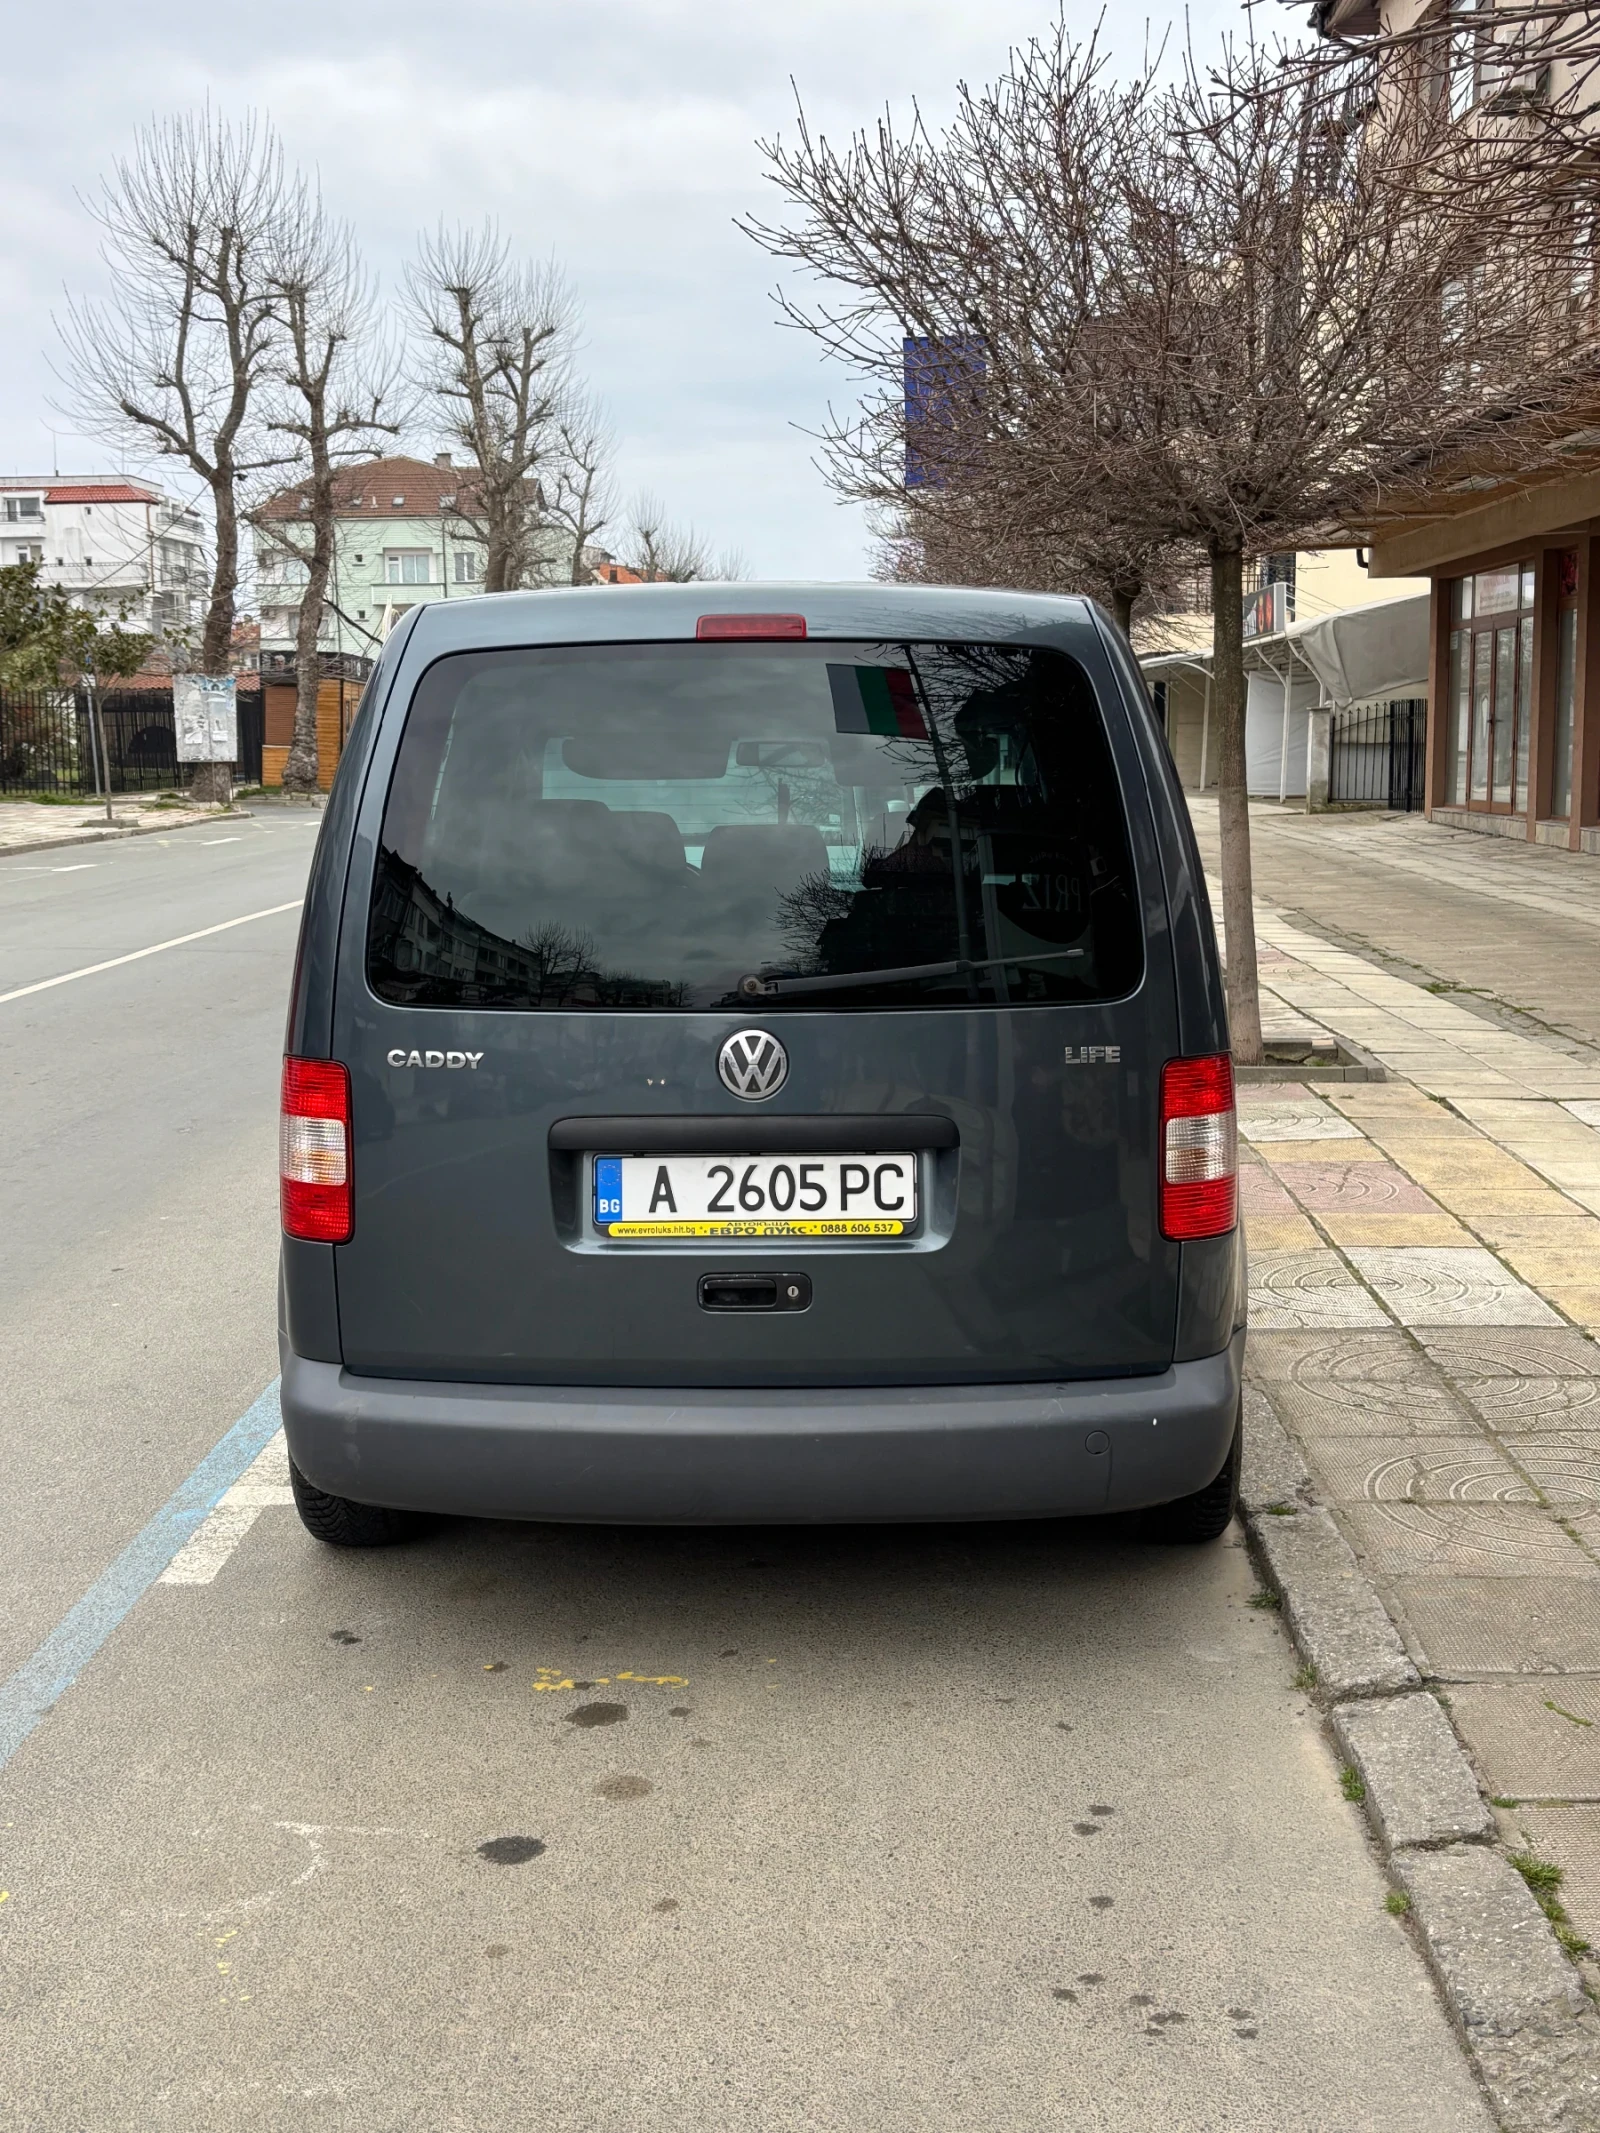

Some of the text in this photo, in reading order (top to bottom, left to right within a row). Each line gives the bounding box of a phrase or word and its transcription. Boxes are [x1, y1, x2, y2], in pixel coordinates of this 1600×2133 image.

[387, 1049, 485, 1070] CADDY
[719, 1029, 787, 1099] VW
[1065, 1045, 1121, 1064] LIFE
[649, 1166, 677, 1213] A
[599, 1199, 620, 1213] BG
[709, 1227, 757, 1235] ЕВРО
[820, 1223, 894, 1234] 0888 606 537
